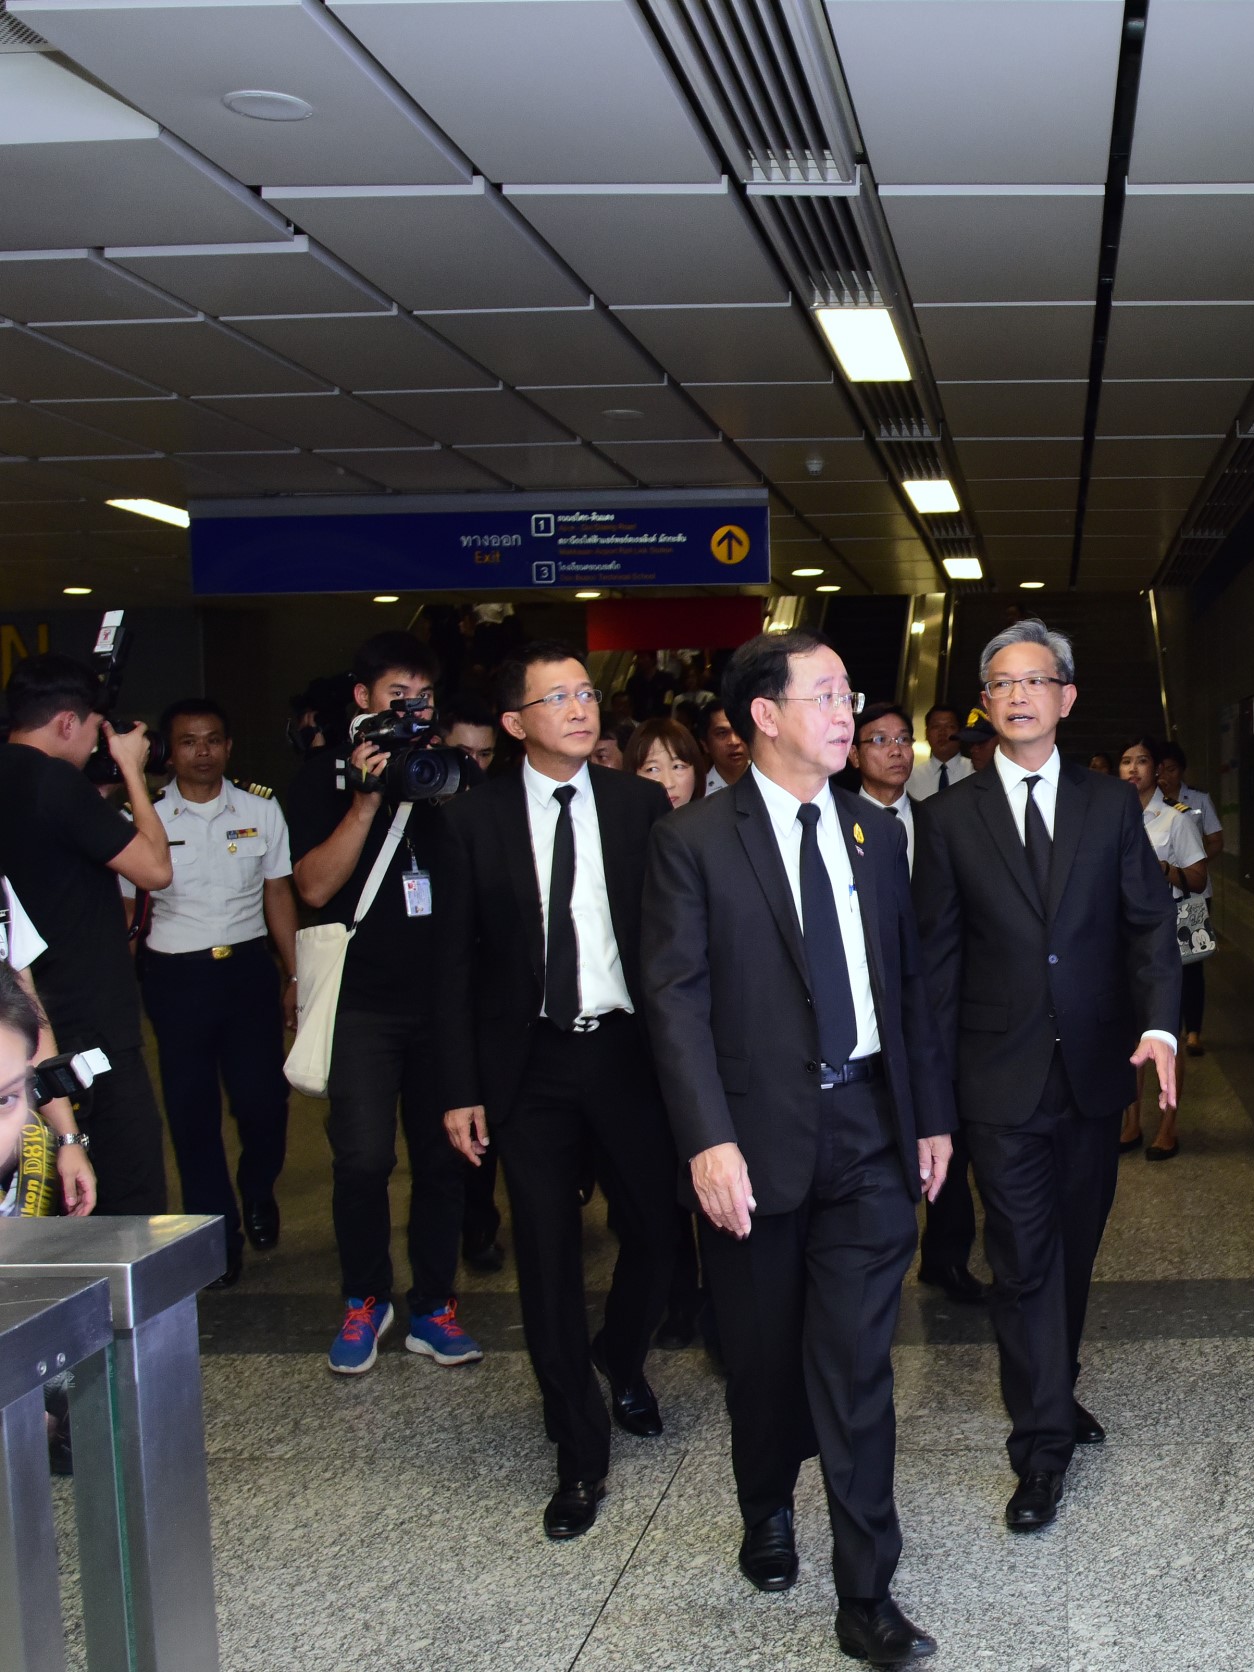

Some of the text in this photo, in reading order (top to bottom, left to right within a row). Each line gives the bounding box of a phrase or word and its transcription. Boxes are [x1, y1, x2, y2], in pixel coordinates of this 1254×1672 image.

[537, 519, 546, 531] 1
[460, 533, 522, 548] ทางออก
[474, 551, 501, 564] Exit
[540, 566, 549, 579] 3
